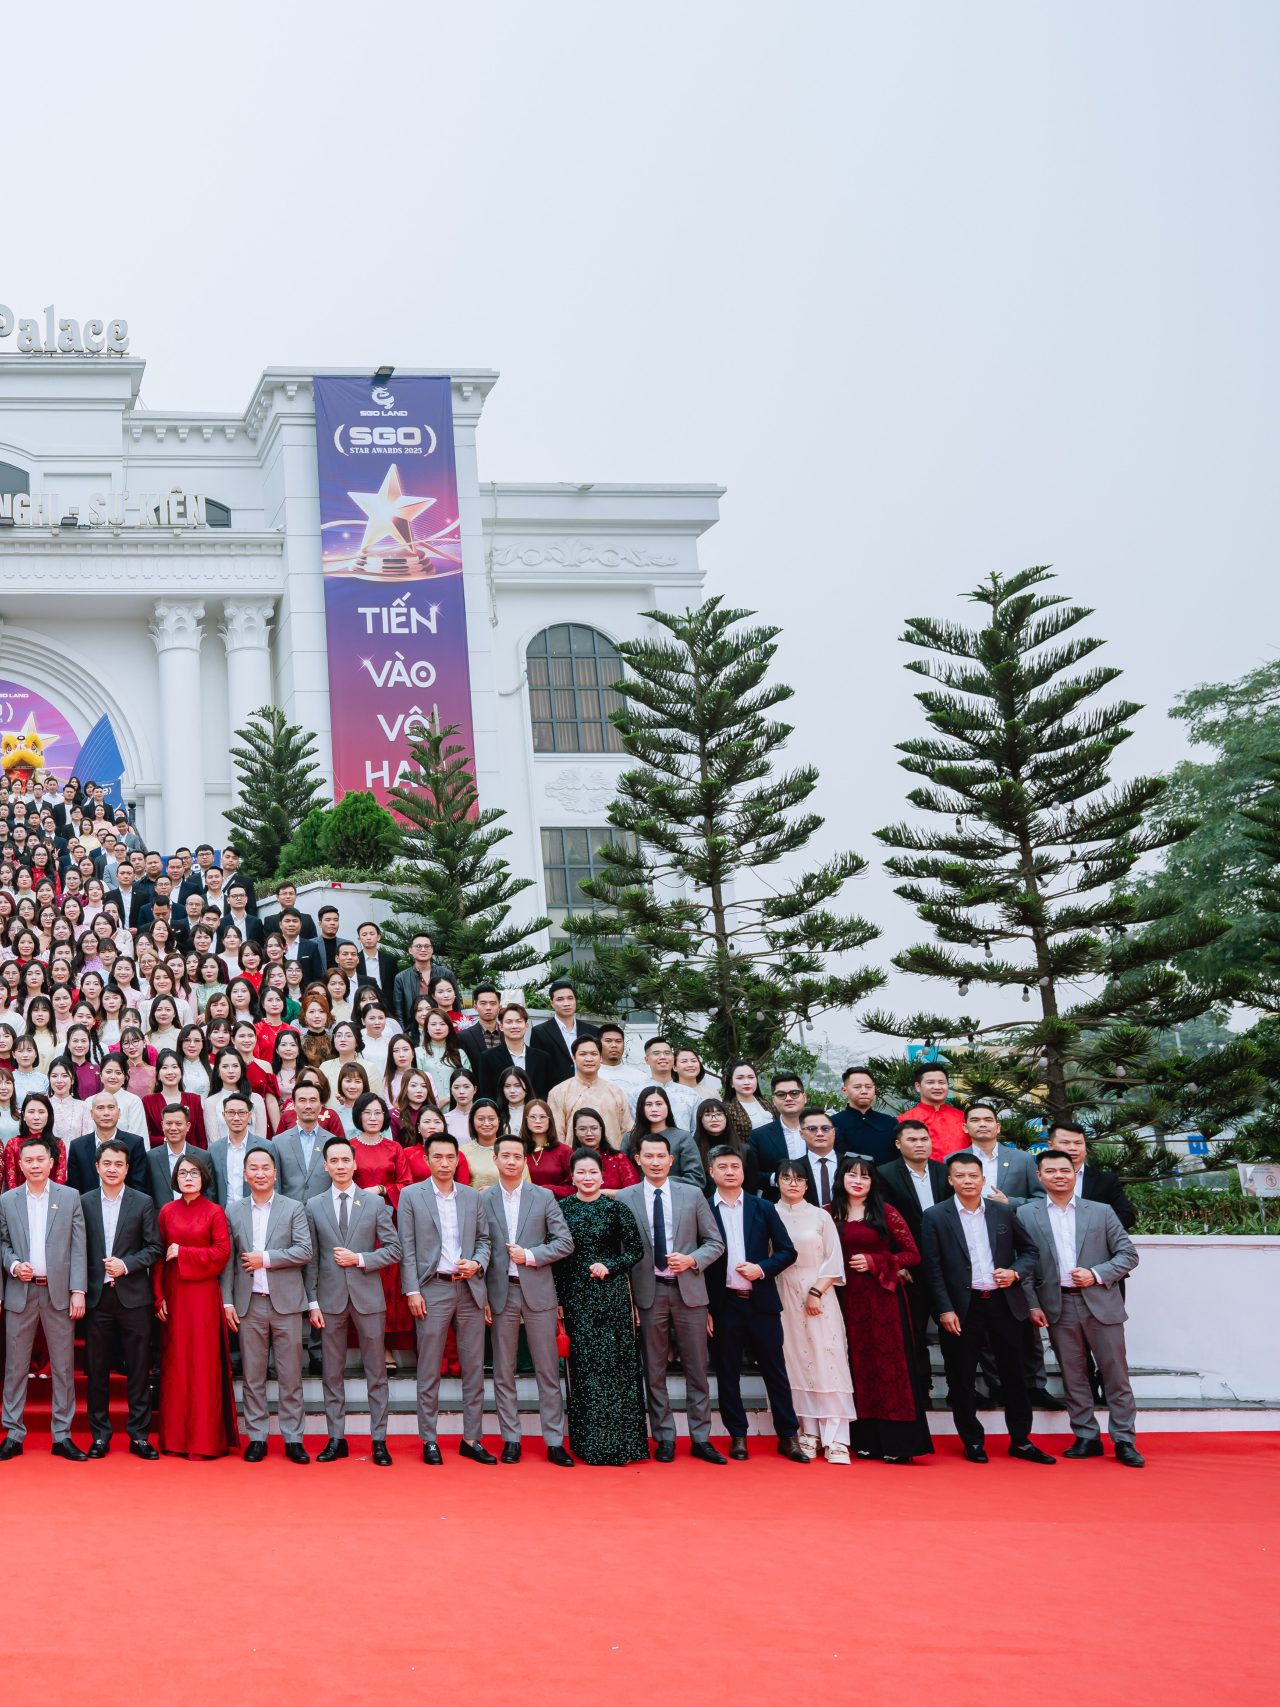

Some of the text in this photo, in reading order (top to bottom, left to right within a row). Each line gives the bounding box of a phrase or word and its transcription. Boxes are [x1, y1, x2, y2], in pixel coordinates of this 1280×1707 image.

[349, 427, 422, 446] SGO
[358, 592, 438, 634] TIẾN
[362, 651, 437, 688] VÀO
[377, 705, 431, 742] VÔ
